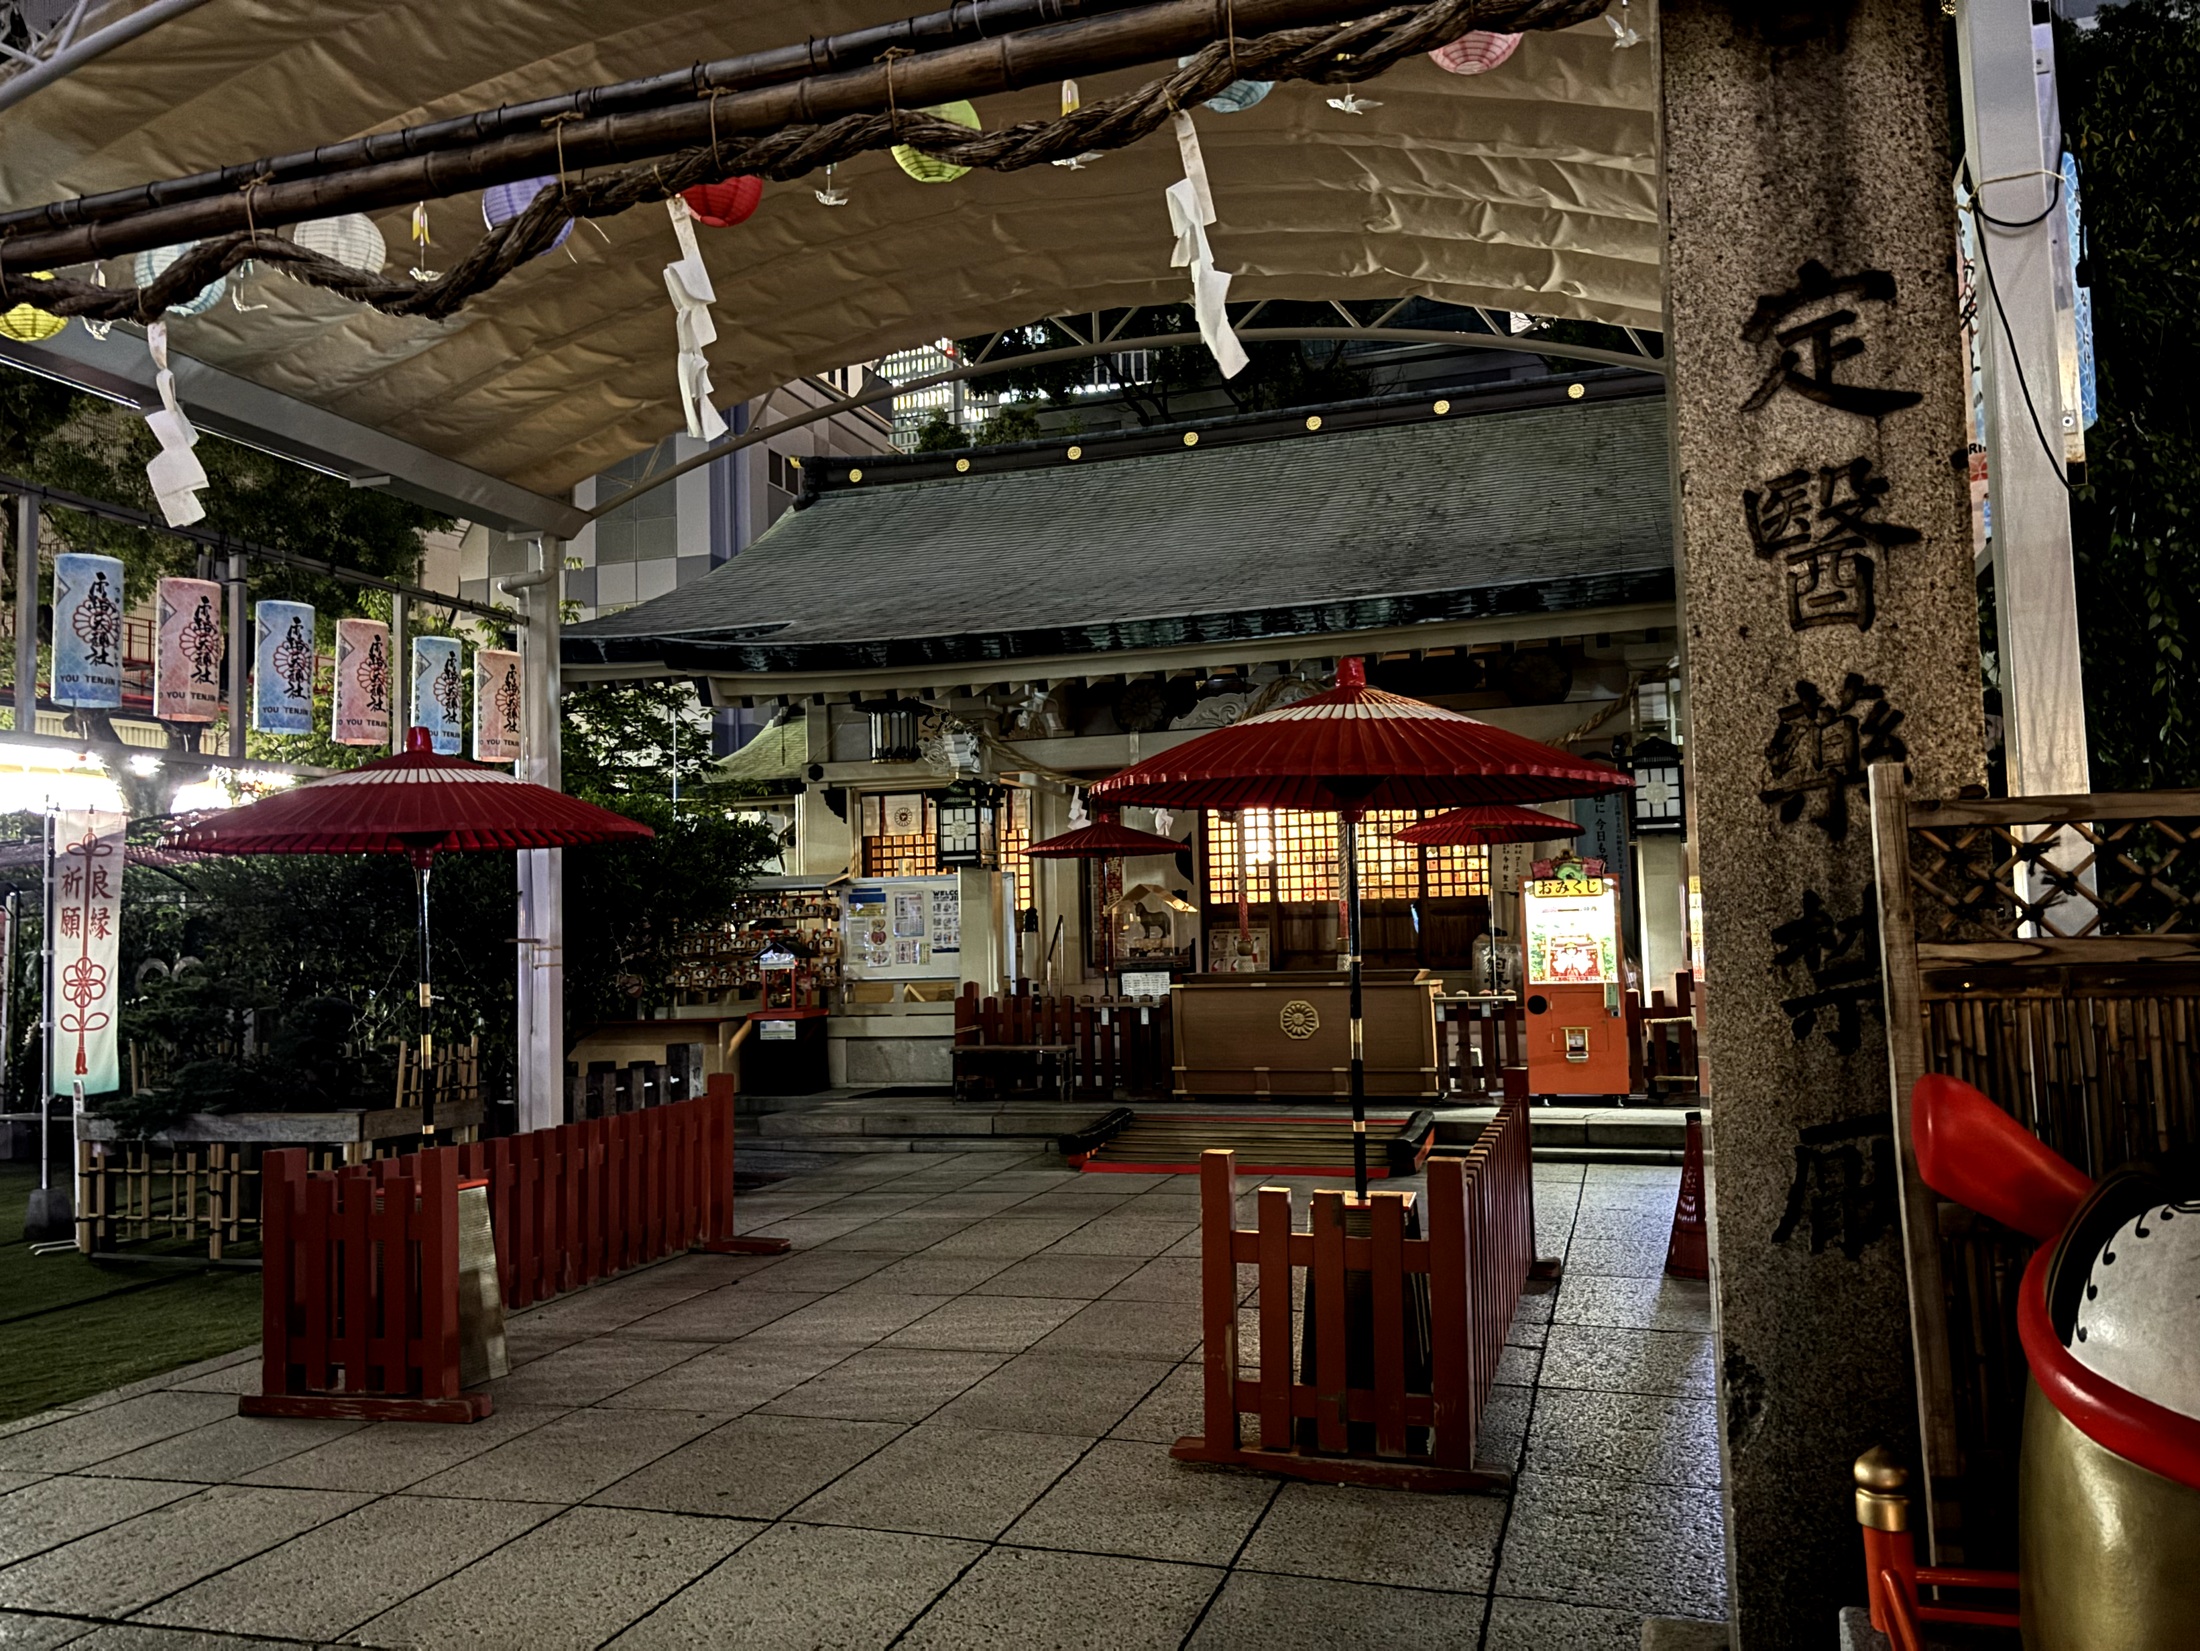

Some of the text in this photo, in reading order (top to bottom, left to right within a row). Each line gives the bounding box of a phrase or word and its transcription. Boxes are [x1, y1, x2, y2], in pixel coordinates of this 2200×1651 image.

[60, 675, 79, 683] YOU
[85, 674, 115, 686] TENJIN
[166, 691, 186, 700] YOU
[262, 706, 279, 714] YOU
[1538, 879, 1598, 895] おみくじ
[61, 865, 84, 939] 祈願
[89, 863, 114, 941] 良縁
